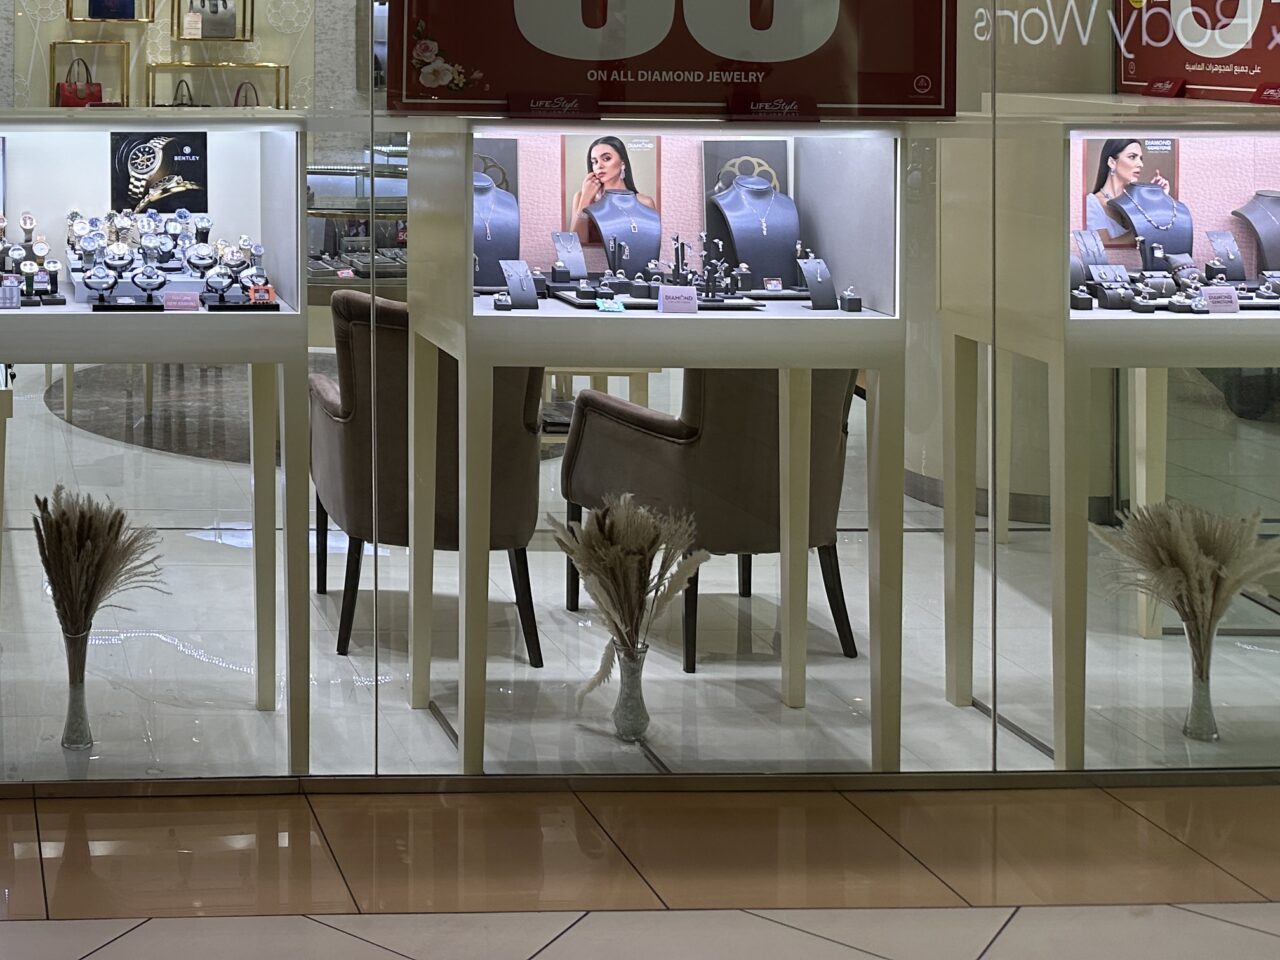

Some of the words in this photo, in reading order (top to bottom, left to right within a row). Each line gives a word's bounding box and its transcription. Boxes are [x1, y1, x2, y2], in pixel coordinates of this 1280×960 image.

[586, 69, 606, 81] ON
[610, 70, 635, 82] ALL
[637, 70, 704, 83] DIAMOND
[706, 71, 765, 83] JEWELRY
